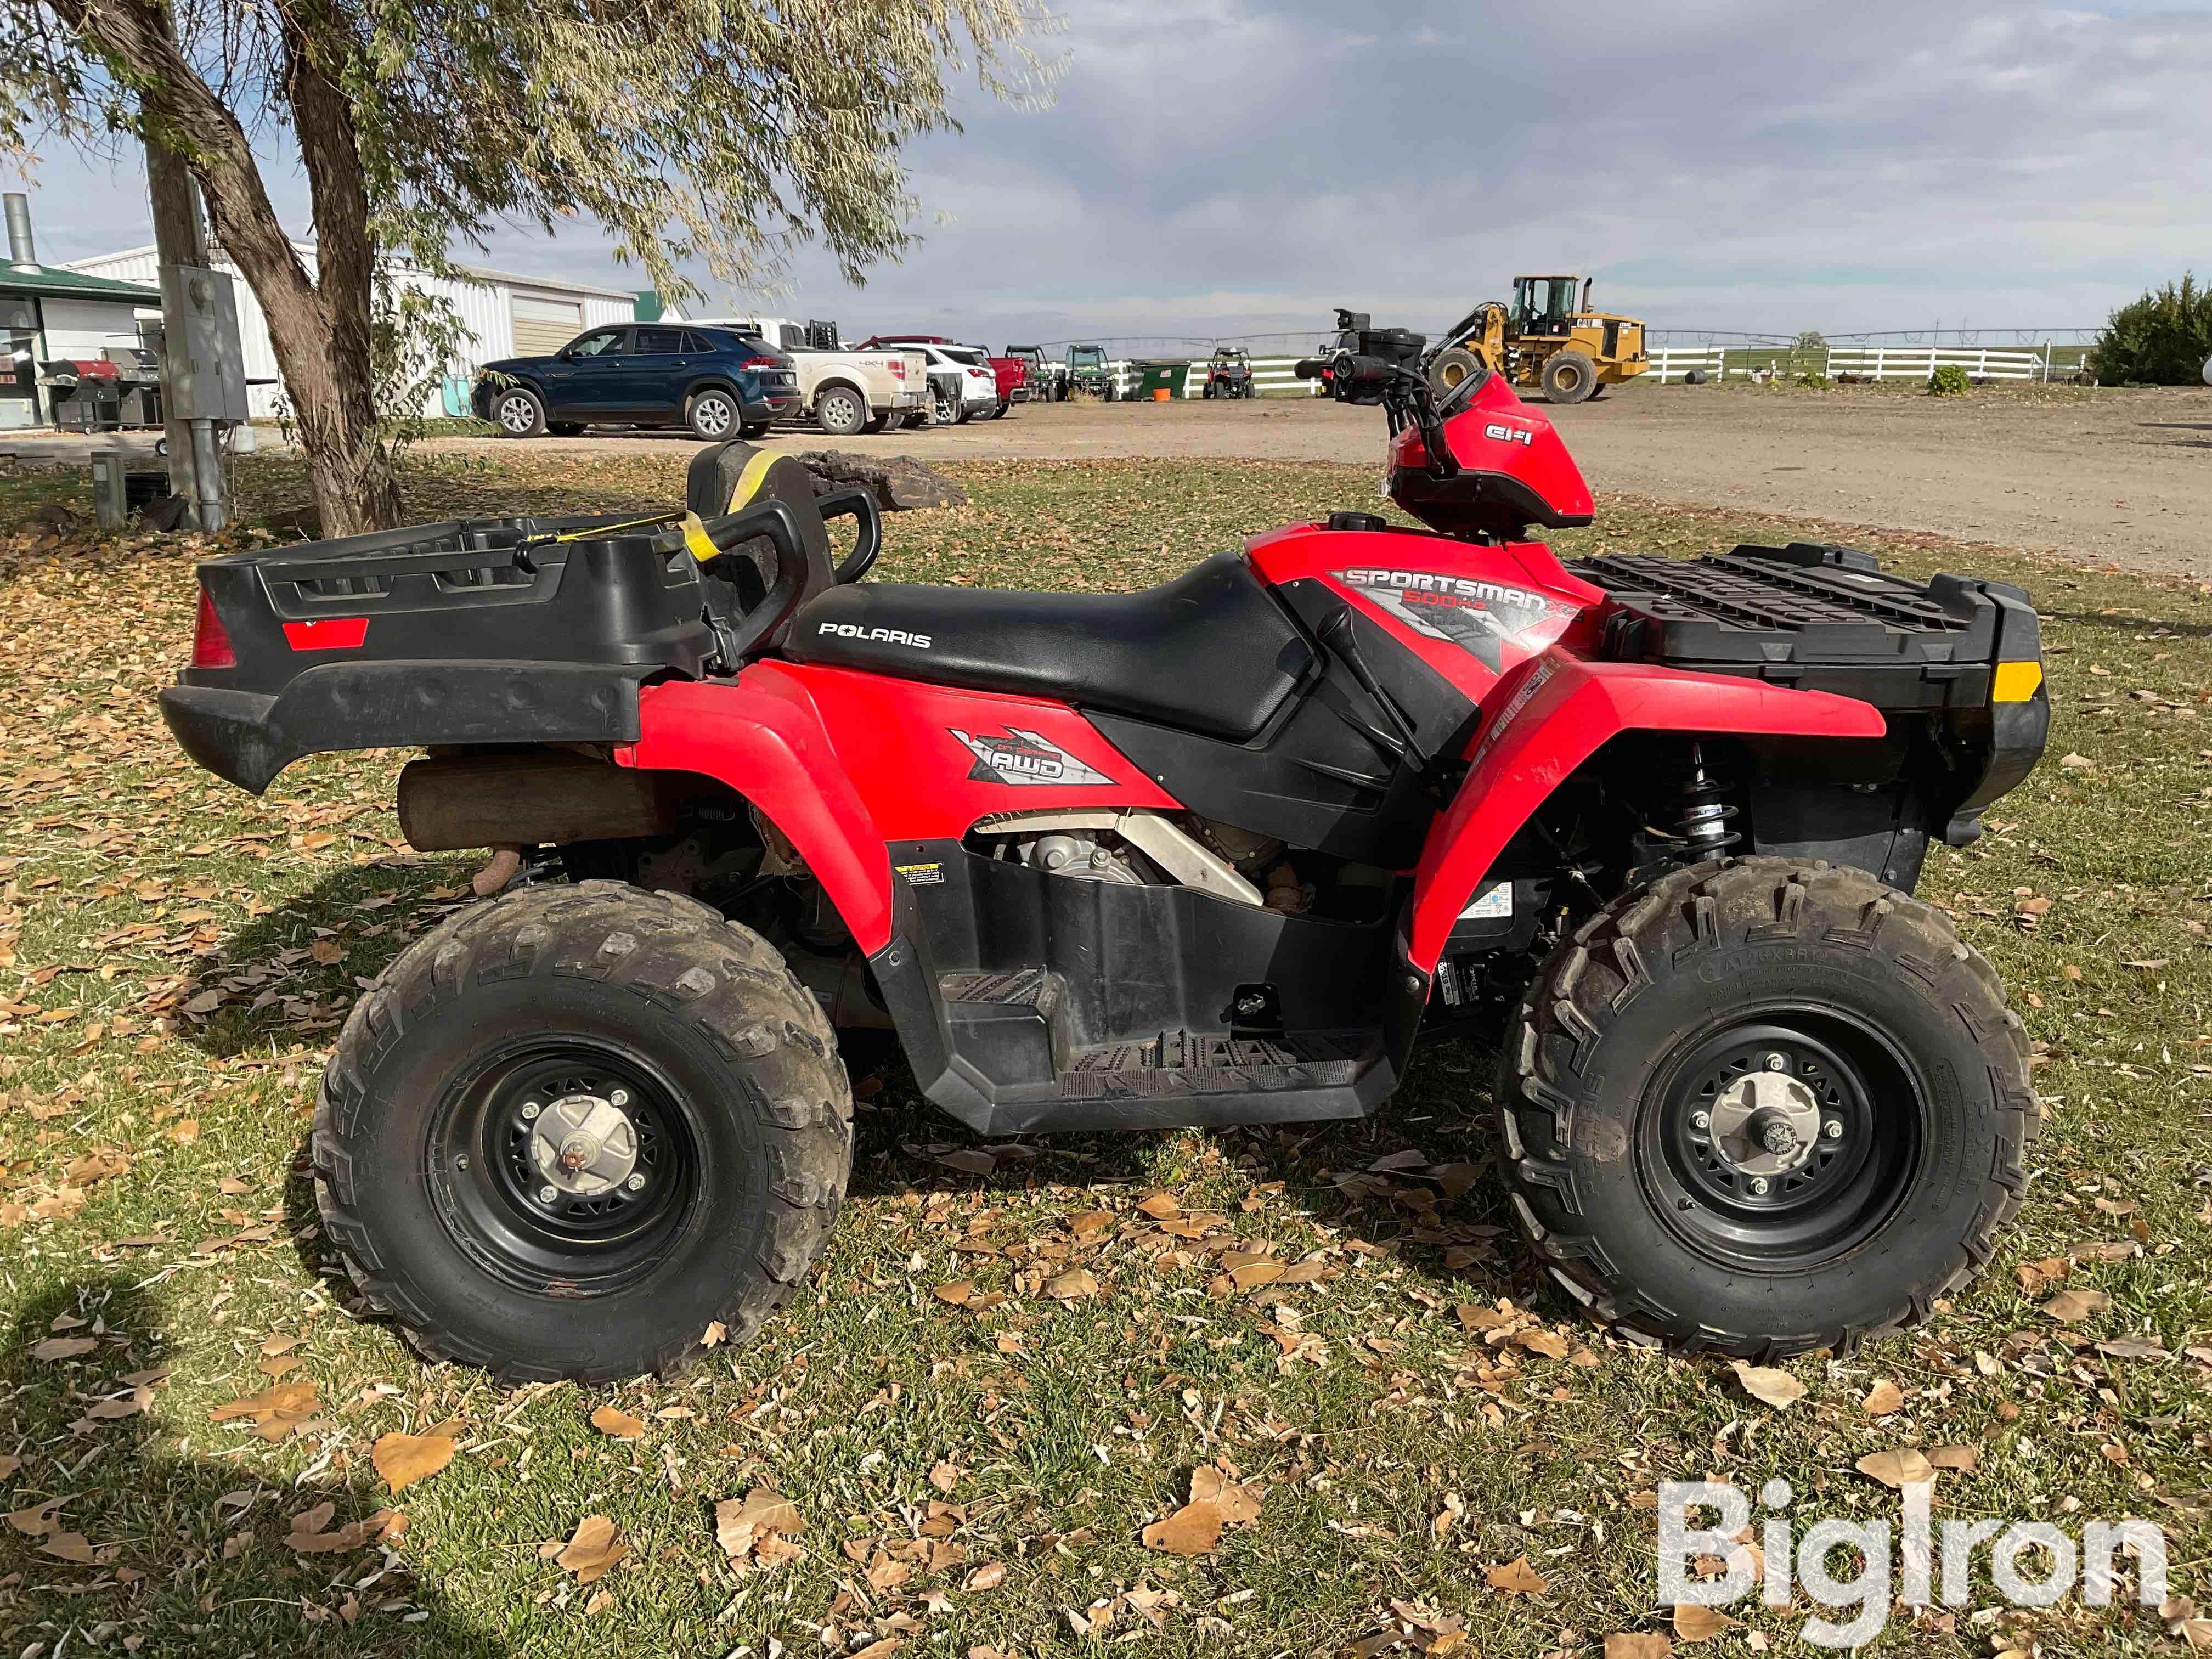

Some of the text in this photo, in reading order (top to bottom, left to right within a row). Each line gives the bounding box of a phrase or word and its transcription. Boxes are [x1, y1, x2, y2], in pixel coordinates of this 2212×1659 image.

[1345, 569, 1546, 609] SPORTSMAN
[818, 623, 932, 649] POLARIS
[991, 752, 1063, 777] AWD
